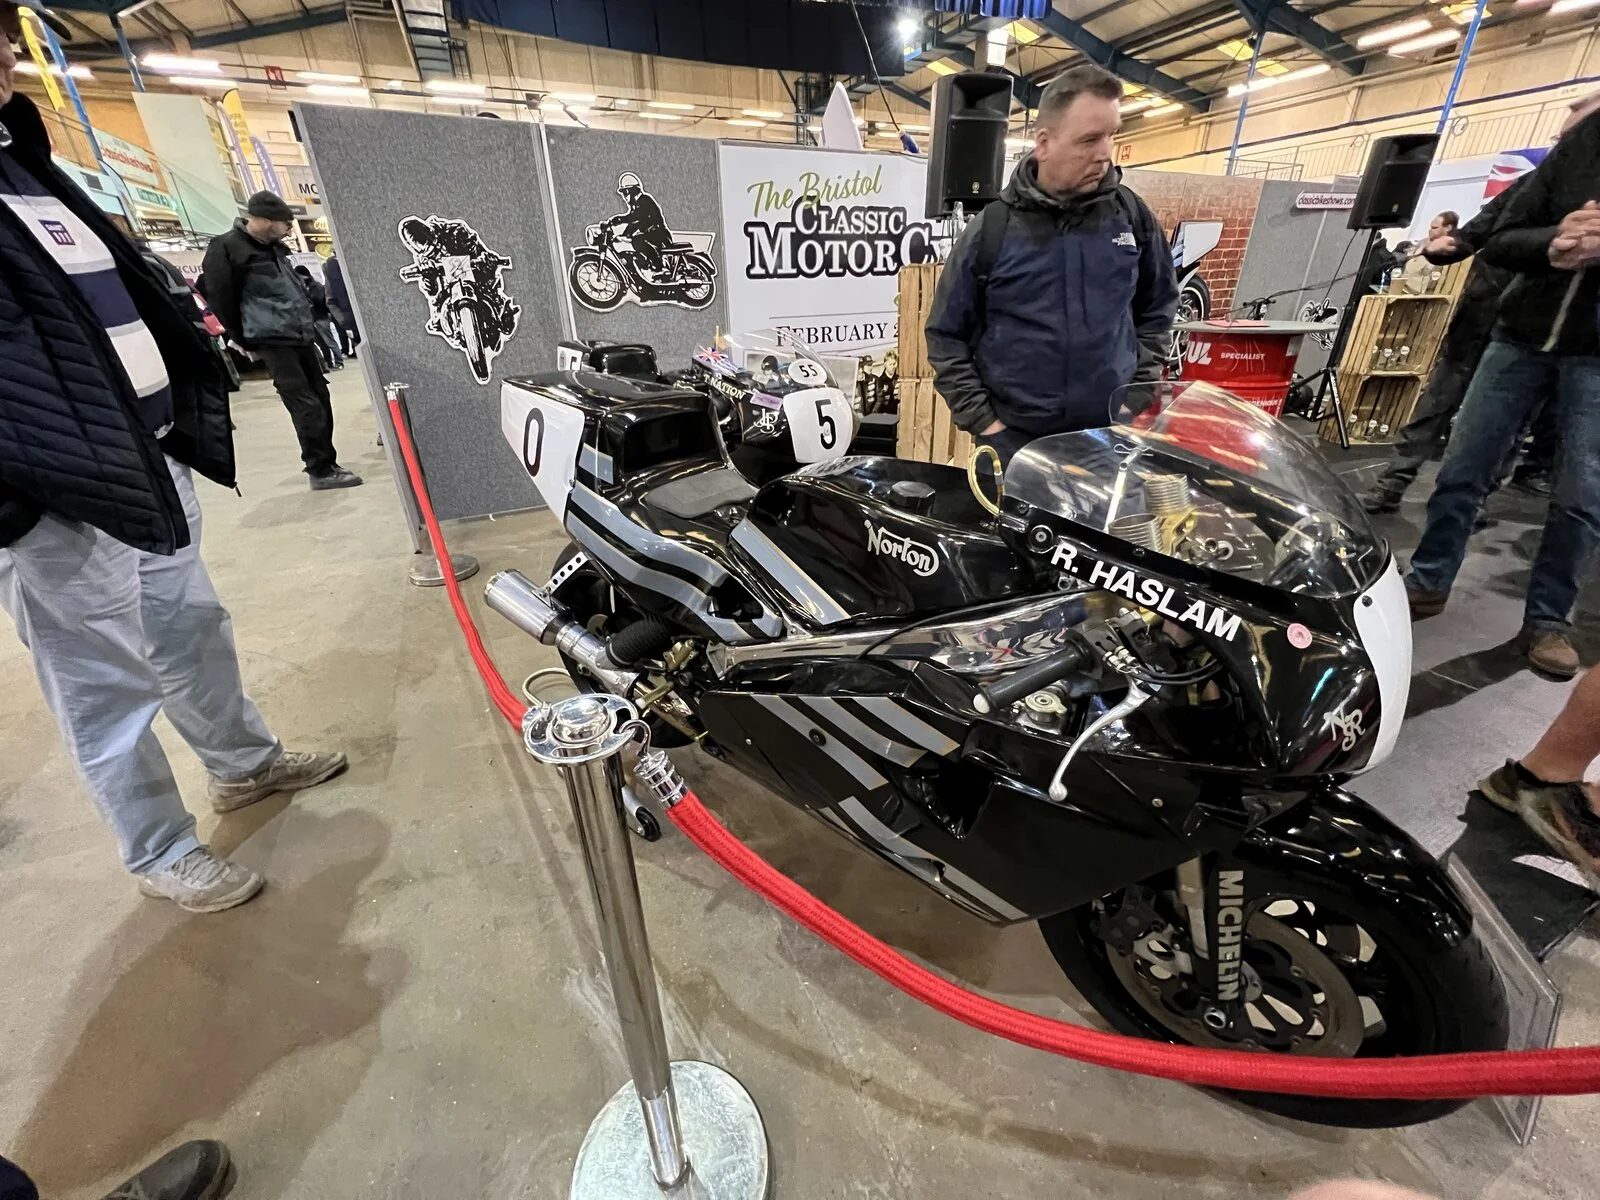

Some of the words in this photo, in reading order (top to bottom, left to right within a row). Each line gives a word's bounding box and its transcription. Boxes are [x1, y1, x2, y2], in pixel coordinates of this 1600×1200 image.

[747, 181, 794, 217] The
[799, 164, 882, 209] Bristol
[795, 201, 903, 235] CLASSIC
[776, 322, 888, 347] FEBRUARY
[1184, 340, 1212, 365] UL
[1220, 352, 1266, 360] SPECIALIST
[799, 364, 818, 378] 55
[523, 407, 545, 477] 0
[814, 399, 837, 450] 5
[864, 519, 940, 577] Norton
[1050, 542, 1080, 573] R.
[1089, 560, 1242, 642] HASLAM
[1217, 870, 1244, 1001] MICHELIN
